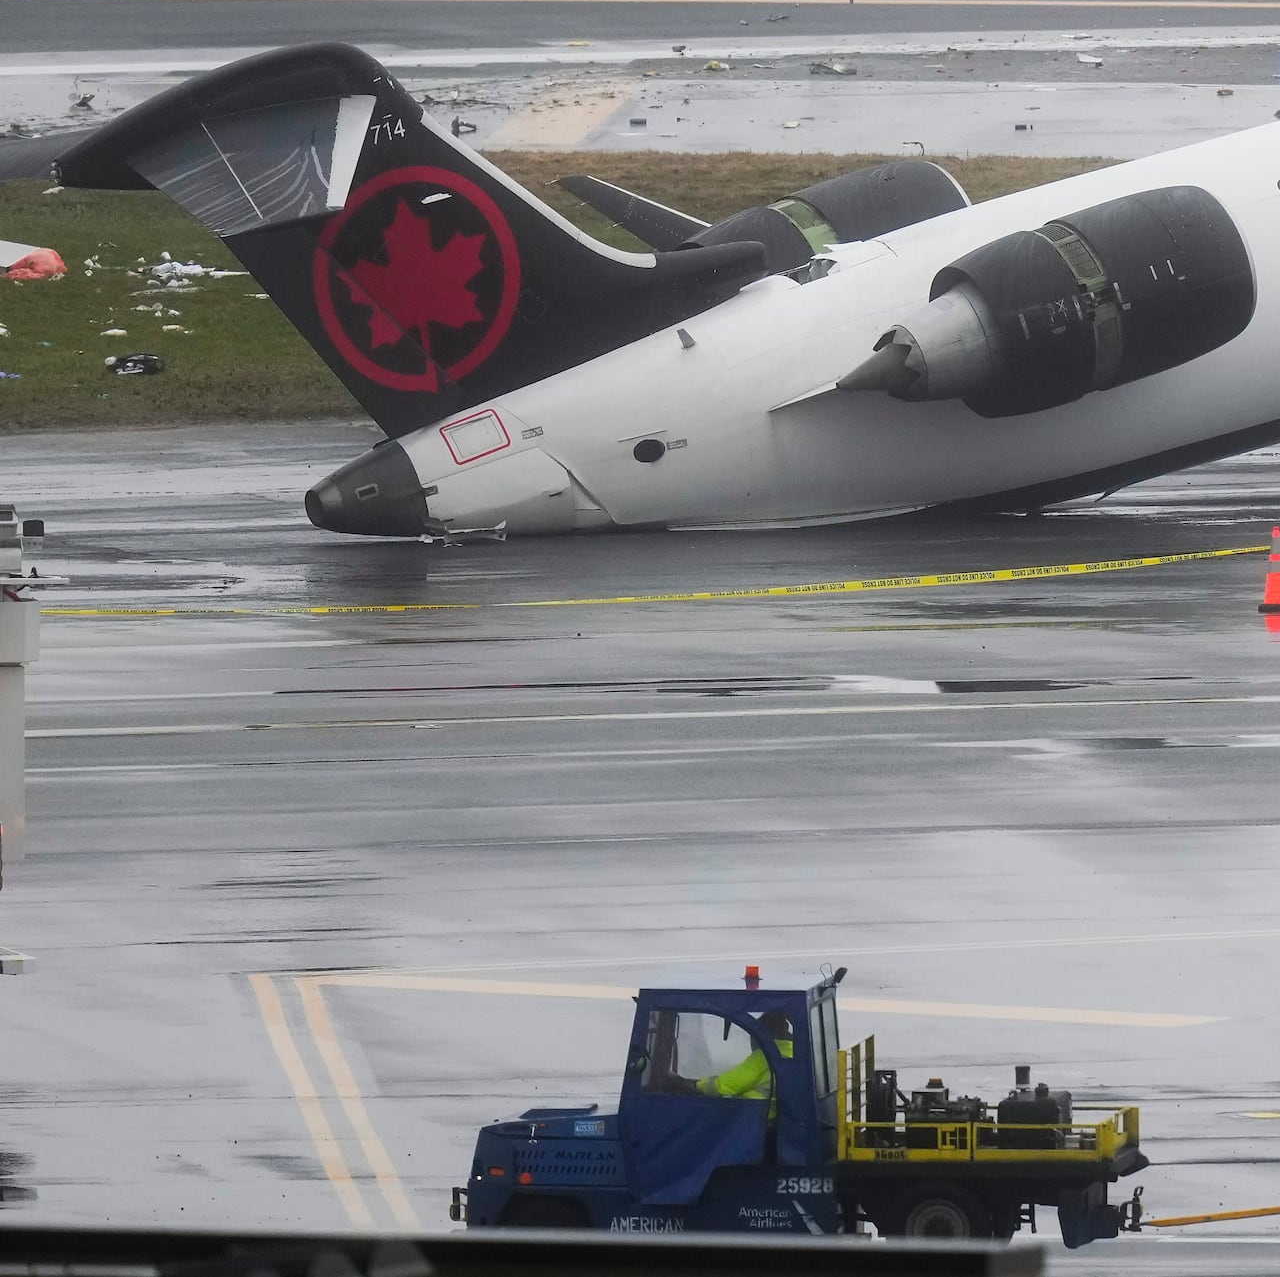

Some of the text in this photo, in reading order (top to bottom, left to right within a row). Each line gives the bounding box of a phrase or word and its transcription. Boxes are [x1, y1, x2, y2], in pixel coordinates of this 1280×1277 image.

[370, 118, 406, 145] 714
[776, 1177, 834, 1194] 25928
[610, 1216, 685, 1234] AMERICAN
